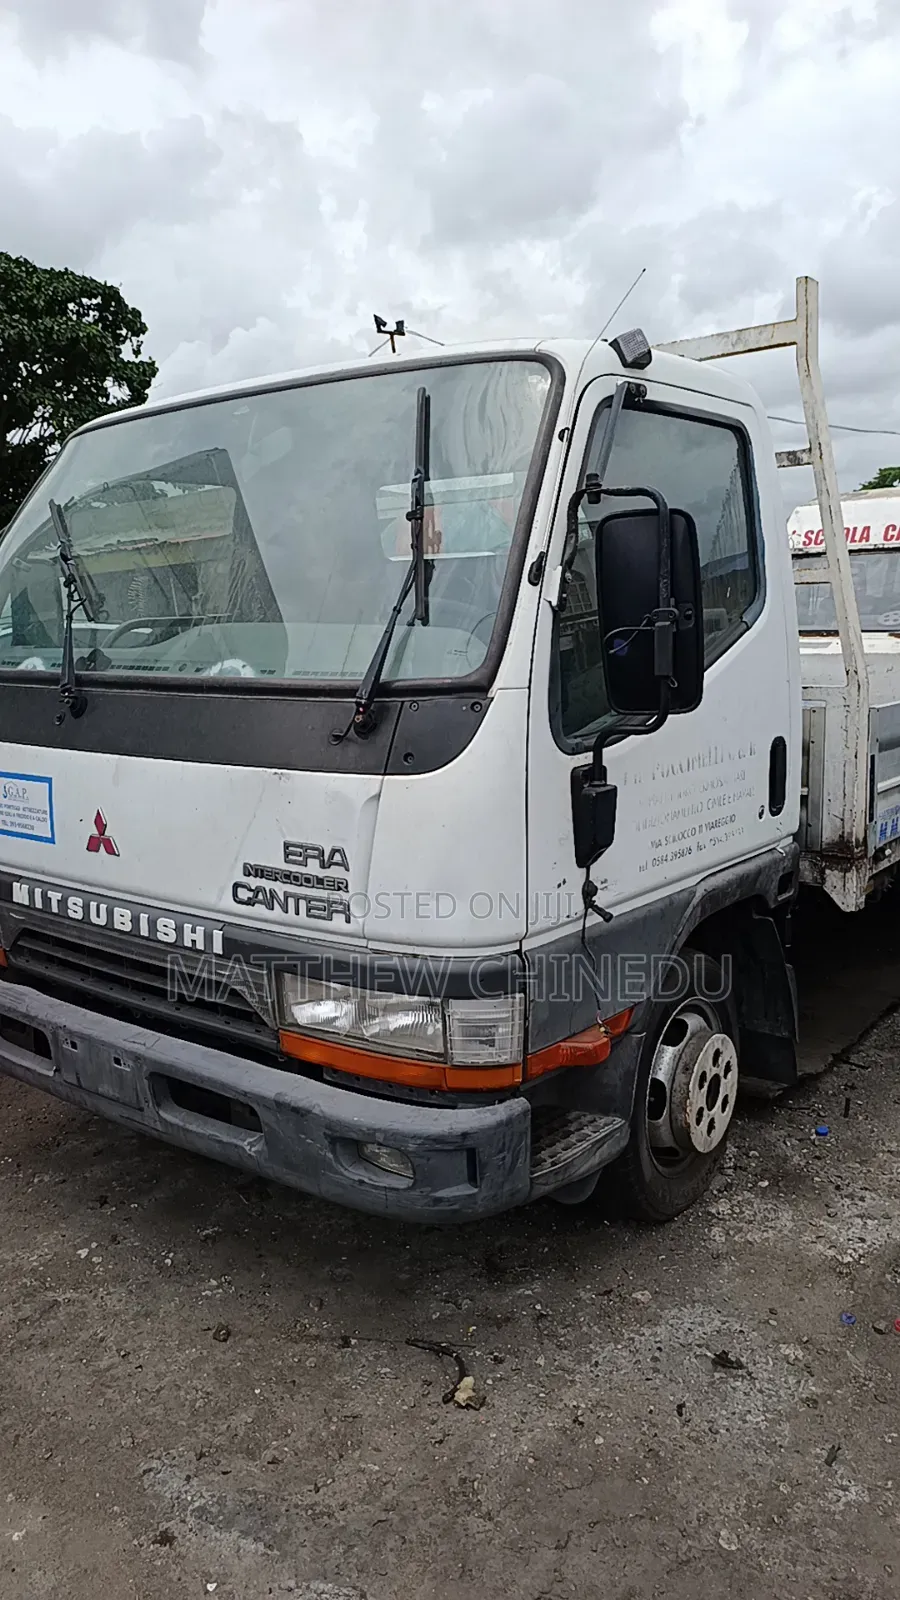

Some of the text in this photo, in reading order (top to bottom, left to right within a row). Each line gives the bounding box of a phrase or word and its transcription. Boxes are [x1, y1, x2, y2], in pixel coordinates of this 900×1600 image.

[803, 526, 871, 547] SCOLA
[283, 840, 349, 872] ERA
[12, 882, 224, 955] MITSUBISHI
[232, 881, 351, 924] CANTER
